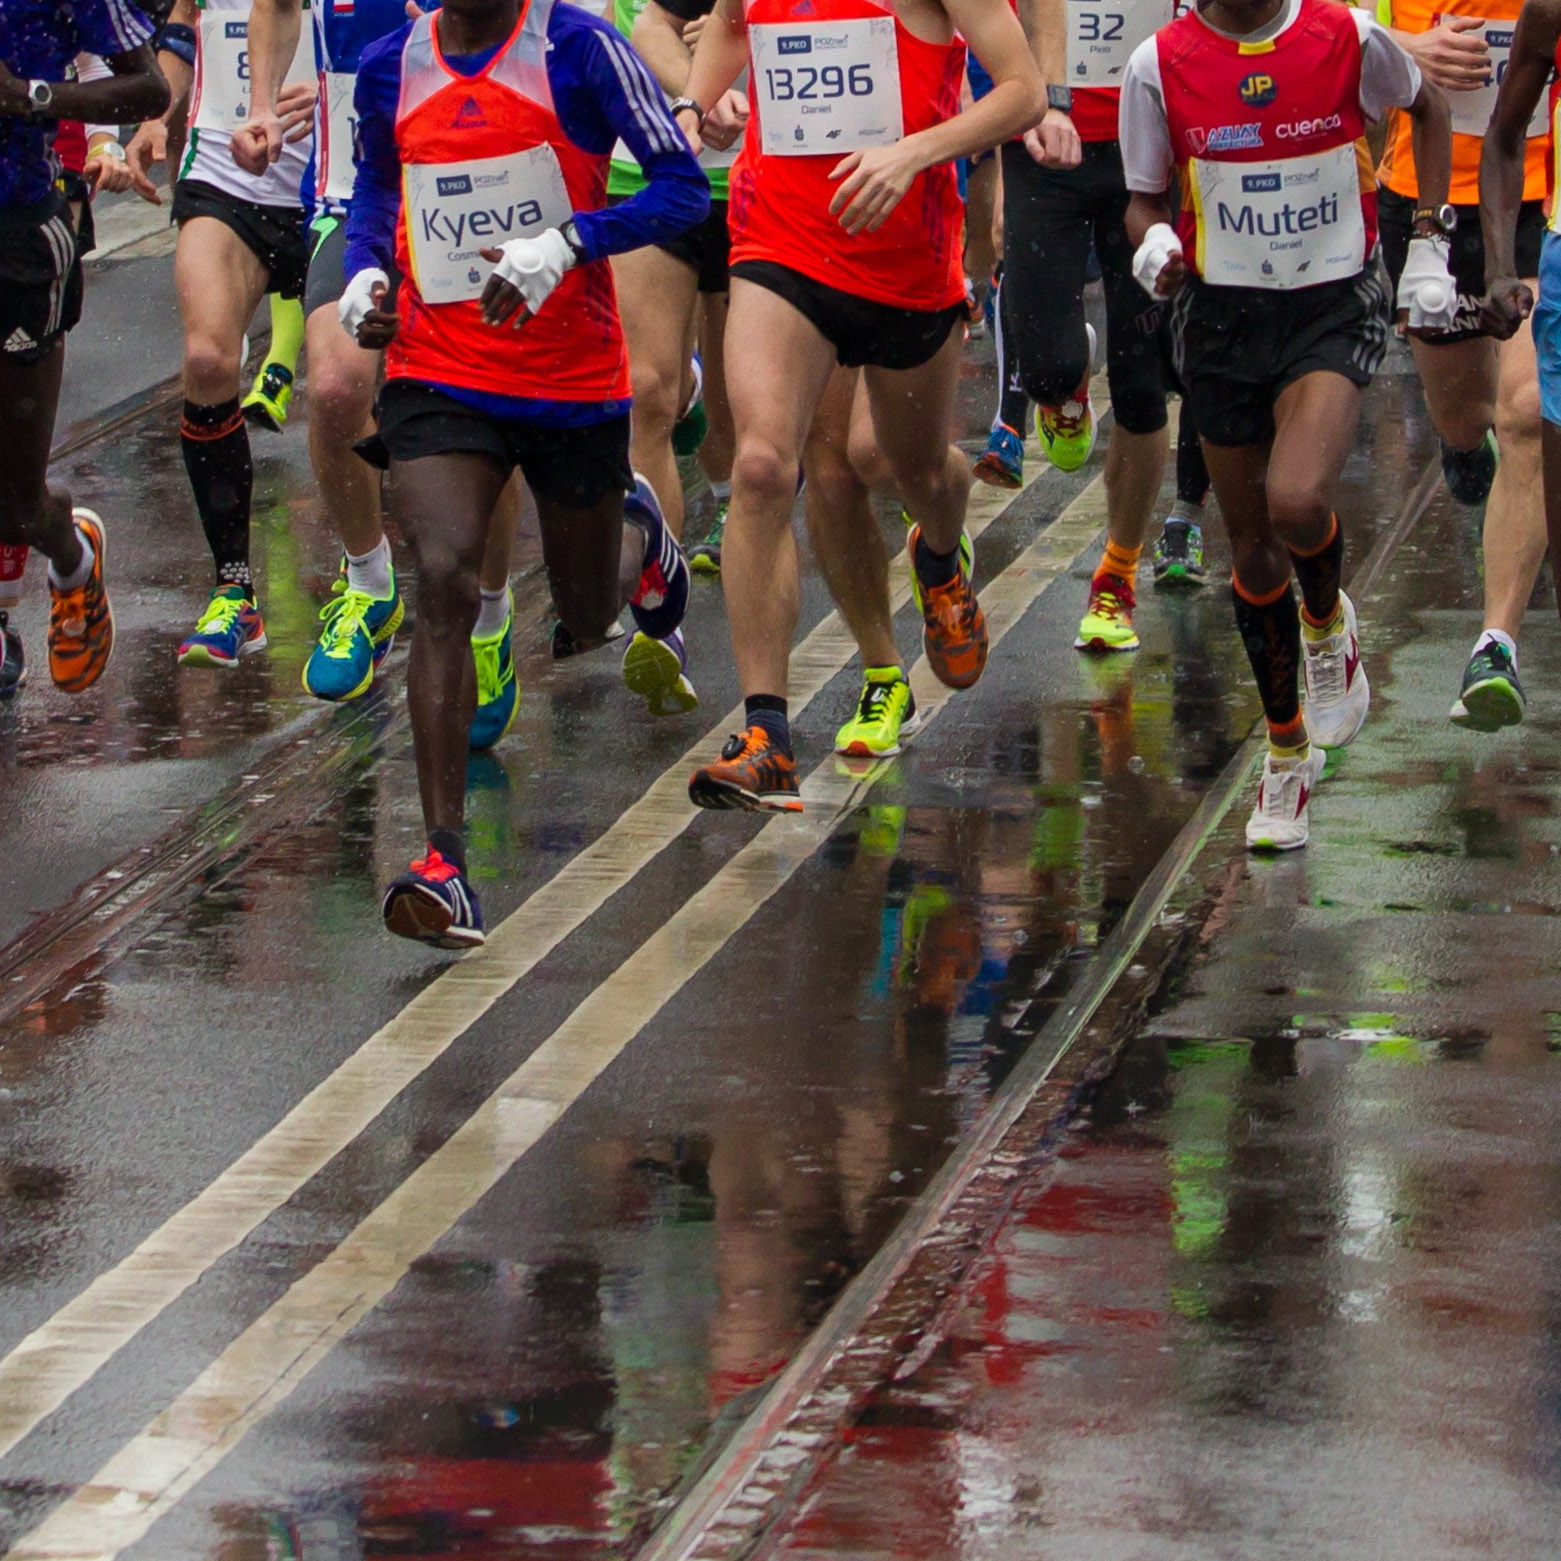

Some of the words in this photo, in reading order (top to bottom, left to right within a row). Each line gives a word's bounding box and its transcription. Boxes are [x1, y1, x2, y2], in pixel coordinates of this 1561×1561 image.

[1078, 13, 1125, 41] 32
[765, 63, 874, 101] 13296
[1241, 75, 1273, 96] JP
[801, 104, 832, 115] Daniel
[1207, 123, 1262, 141] AZUAY
[1275, 113, 1342, 138] cuenca
[421, 199, 543, 248] Kyeva
[1217, 192, 1338, 236] Muteti
[1269, 240, 1303, 251] Daniel
